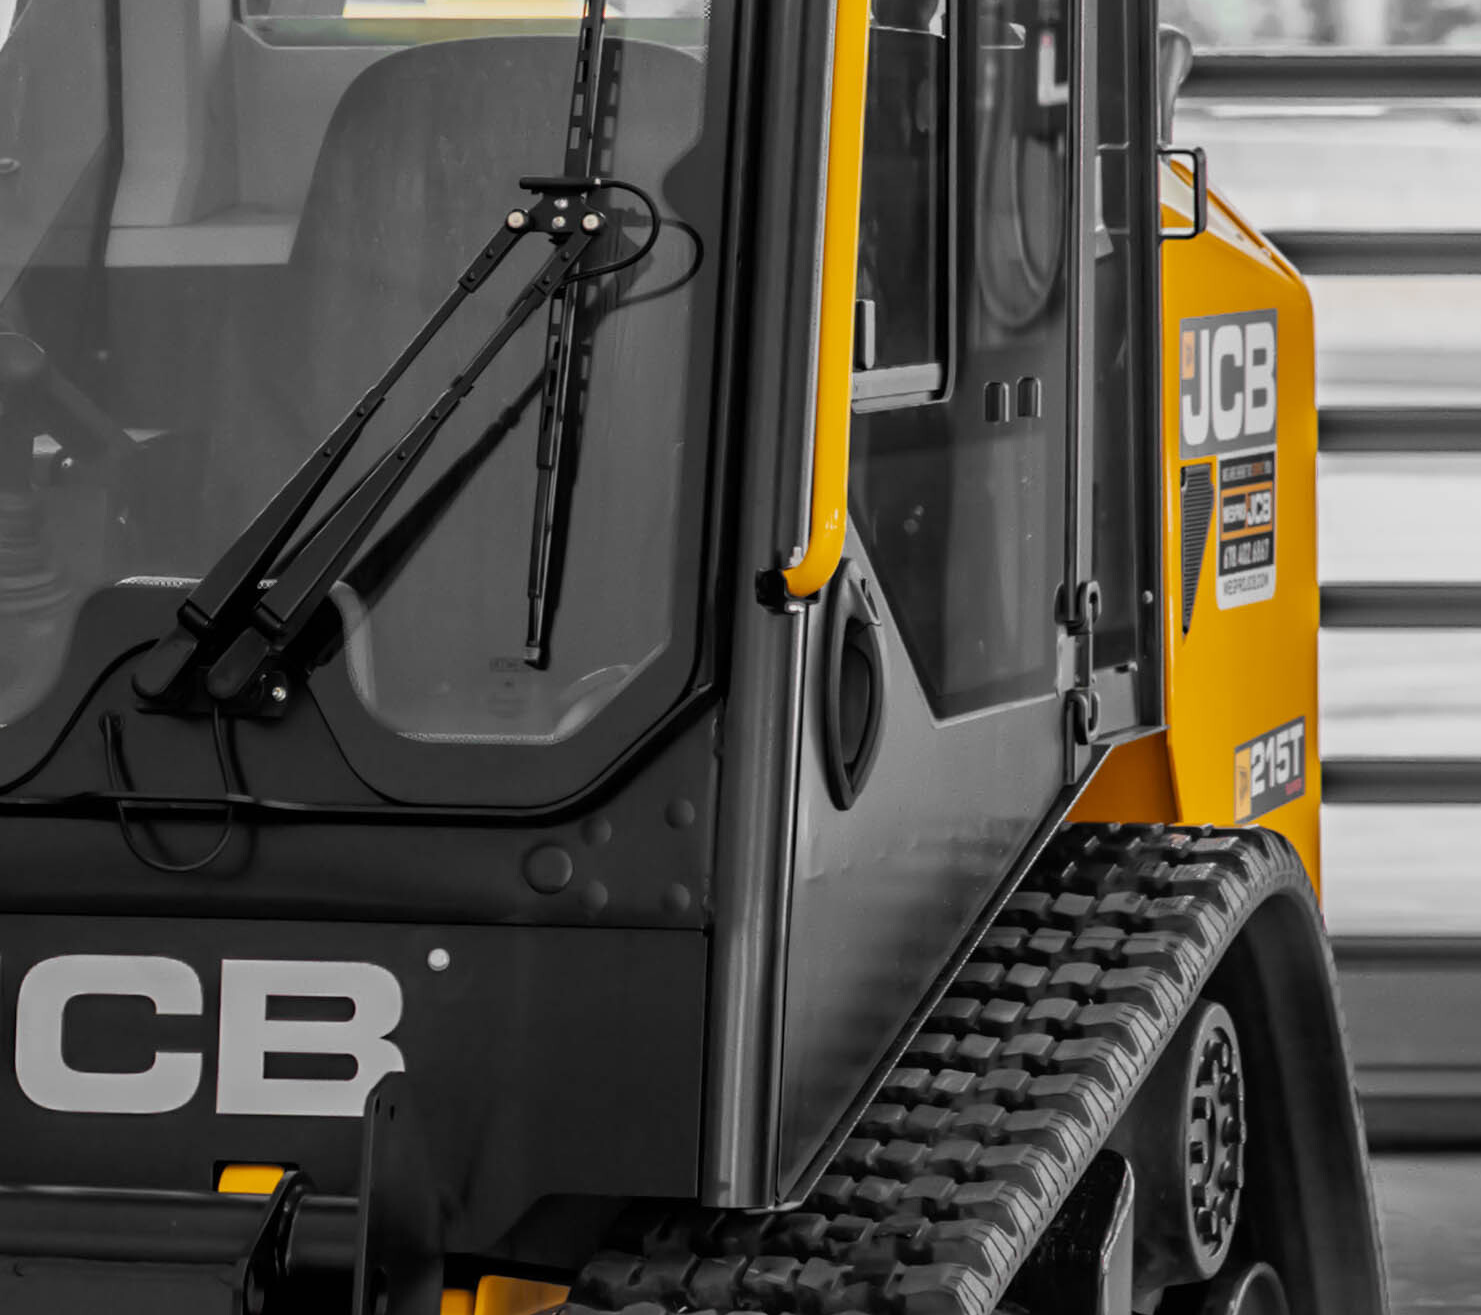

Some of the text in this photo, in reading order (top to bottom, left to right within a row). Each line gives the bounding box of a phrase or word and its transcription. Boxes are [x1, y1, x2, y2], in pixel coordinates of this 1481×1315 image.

[1182, 322, 1275, 446] JCB
[1247, 491, 1271, 526] JCB
[1251, 723, 1303, 798] 215T
